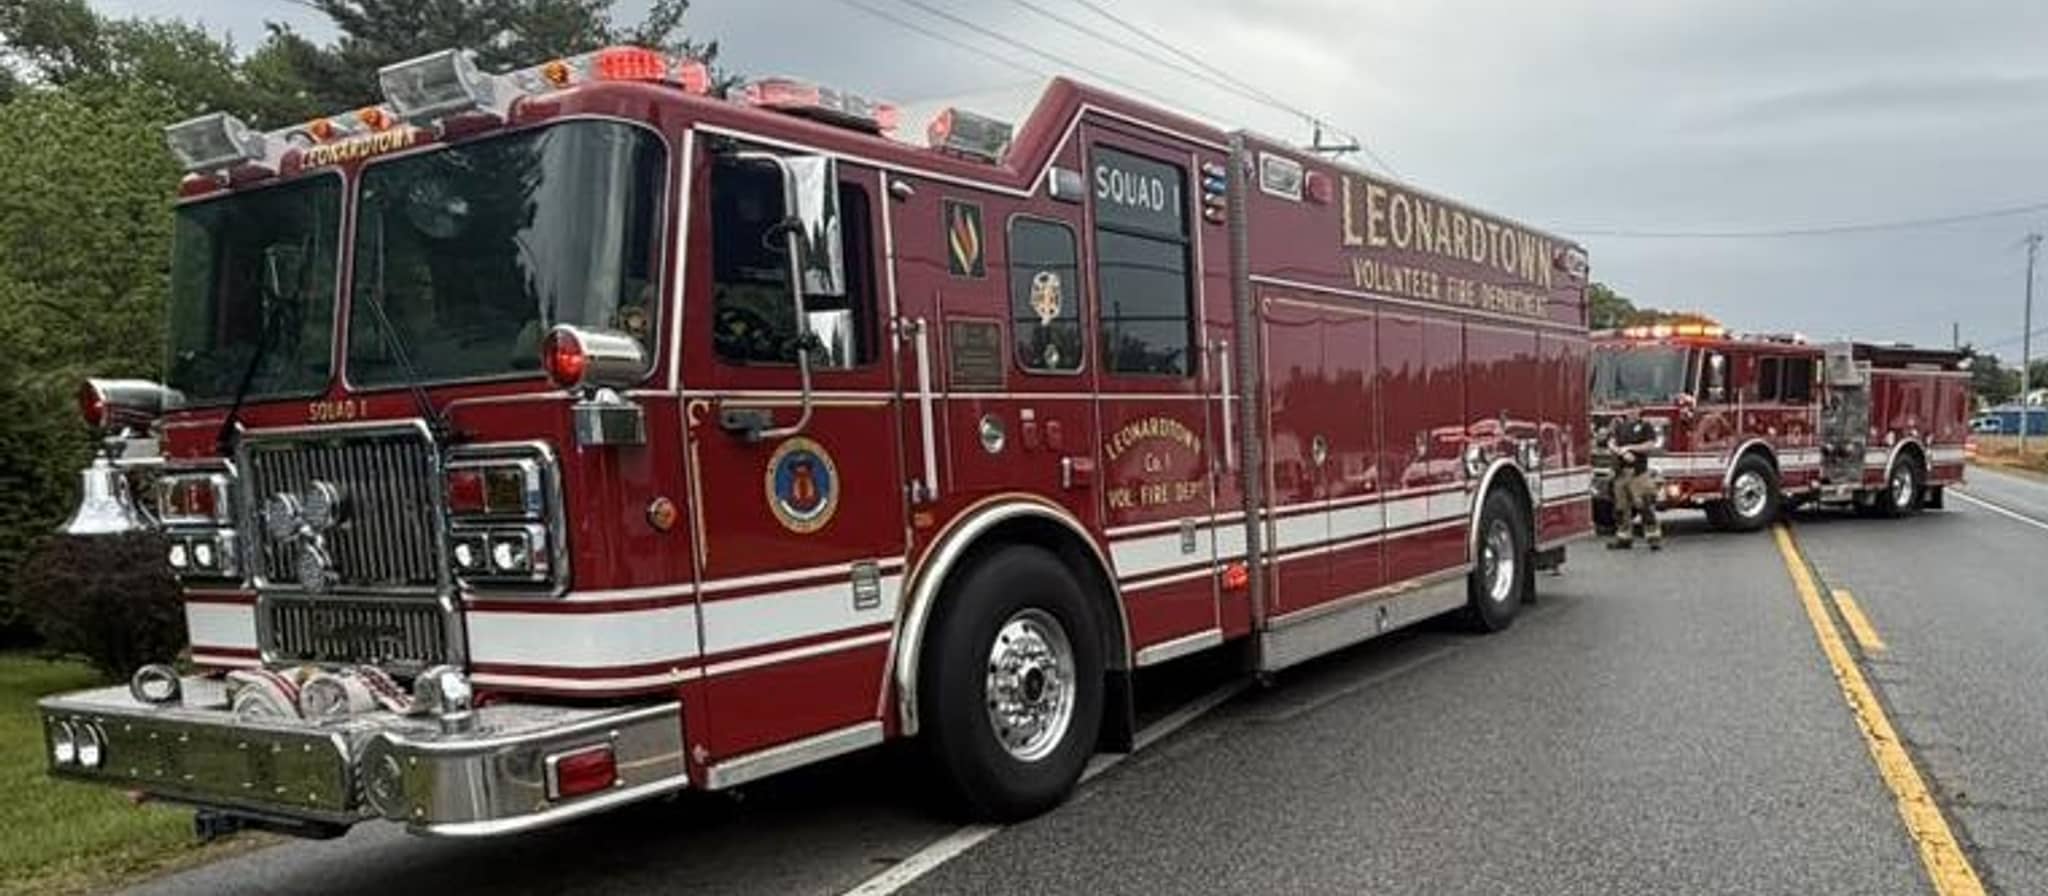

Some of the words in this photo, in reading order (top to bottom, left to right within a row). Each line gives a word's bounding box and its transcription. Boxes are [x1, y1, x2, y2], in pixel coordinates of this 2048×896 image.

[301, 128, 415, 169] LEONARDTOWN
[1096, 165, 1164, 212] SQUAD
[1343, 175, 1551, 290] LEONARDTOWN
[1353, 258, 1439, 300] VOLUNTEER
[1447, 276, 1476, 306] FIRE
[1482, 283, 1548, 319] DEPARTMENT
[308, 401, 357, 421] SQUAD
[1104, 417, 1201, 460] LEONARDTOWN
[1141, 484, 1168, 506] FIRE
